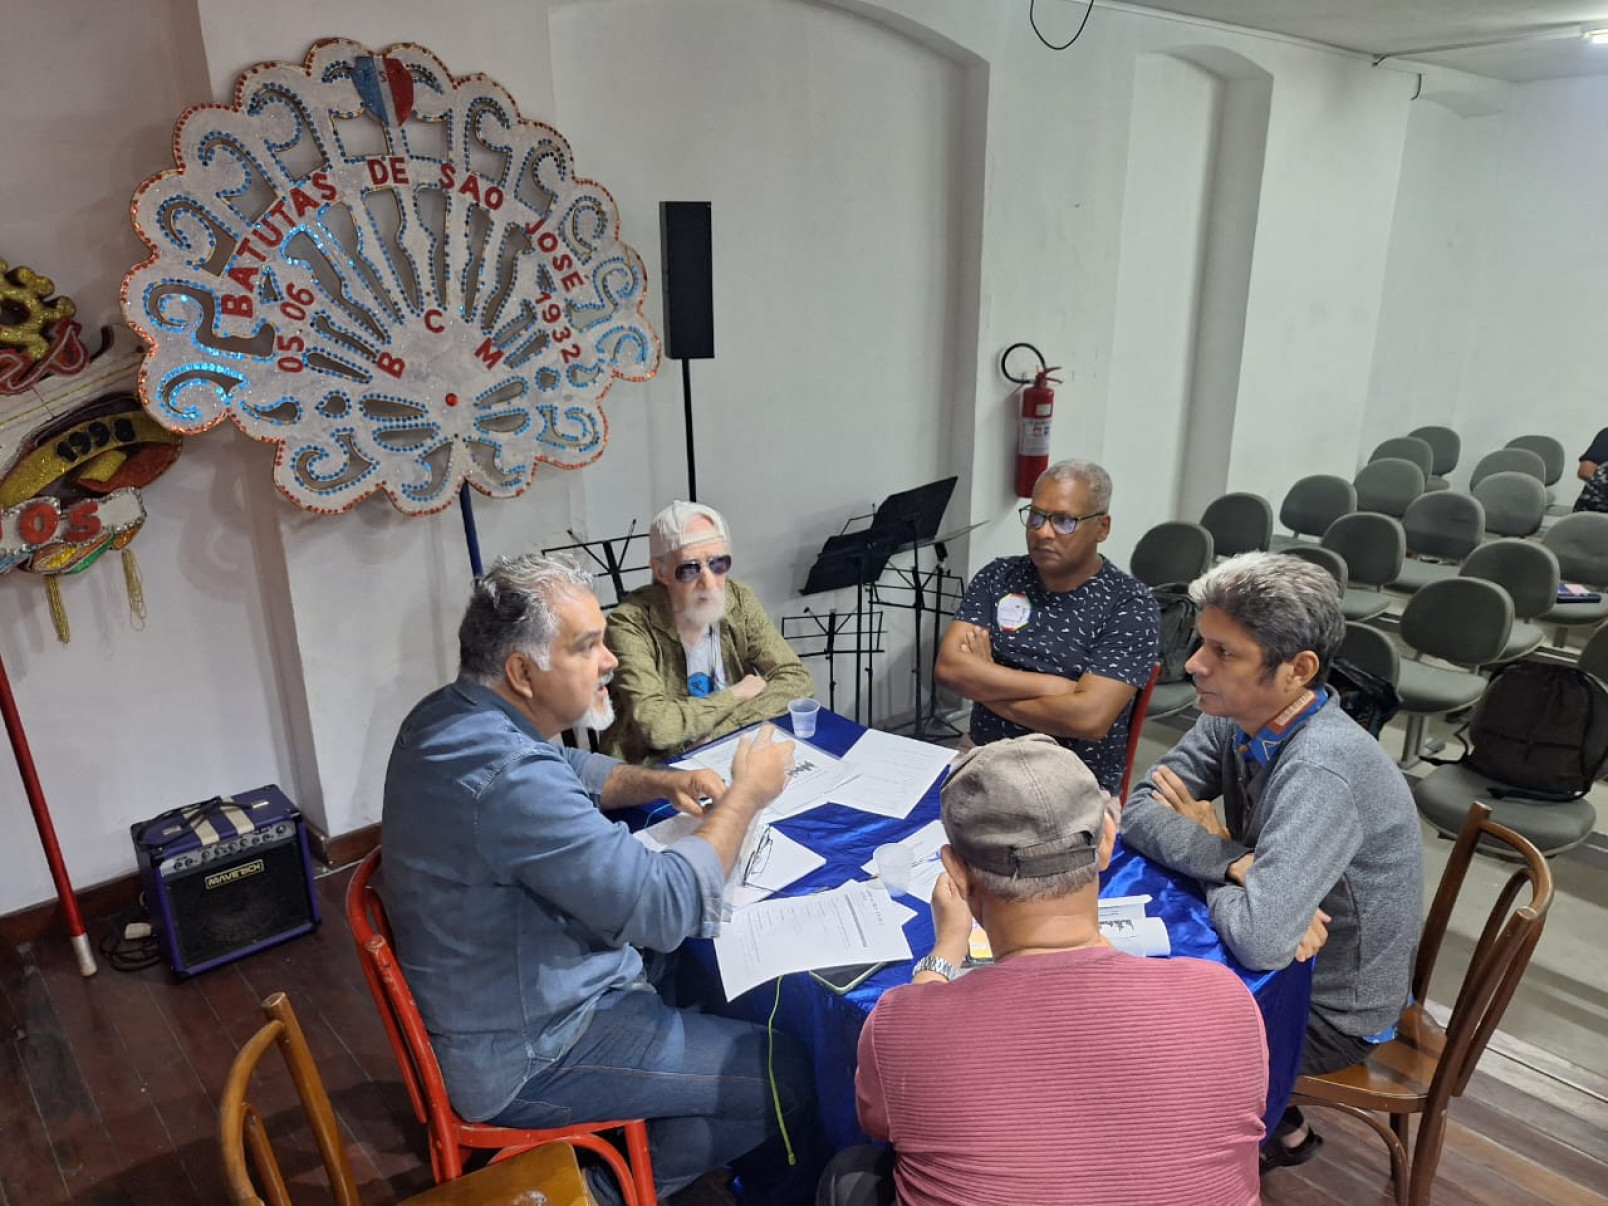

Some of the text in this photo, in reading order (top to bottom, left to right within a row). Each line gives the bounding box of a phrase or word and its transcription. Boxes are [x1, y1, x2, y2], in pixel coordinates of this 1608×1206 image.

[221, 172, 337, 318] BATUTAS
[367, 157, 409, 185] DE
[377, 309, 504, 379] B C M
[535, 291, 581, 364] 1932
[0, 501, 102, 545] OS
